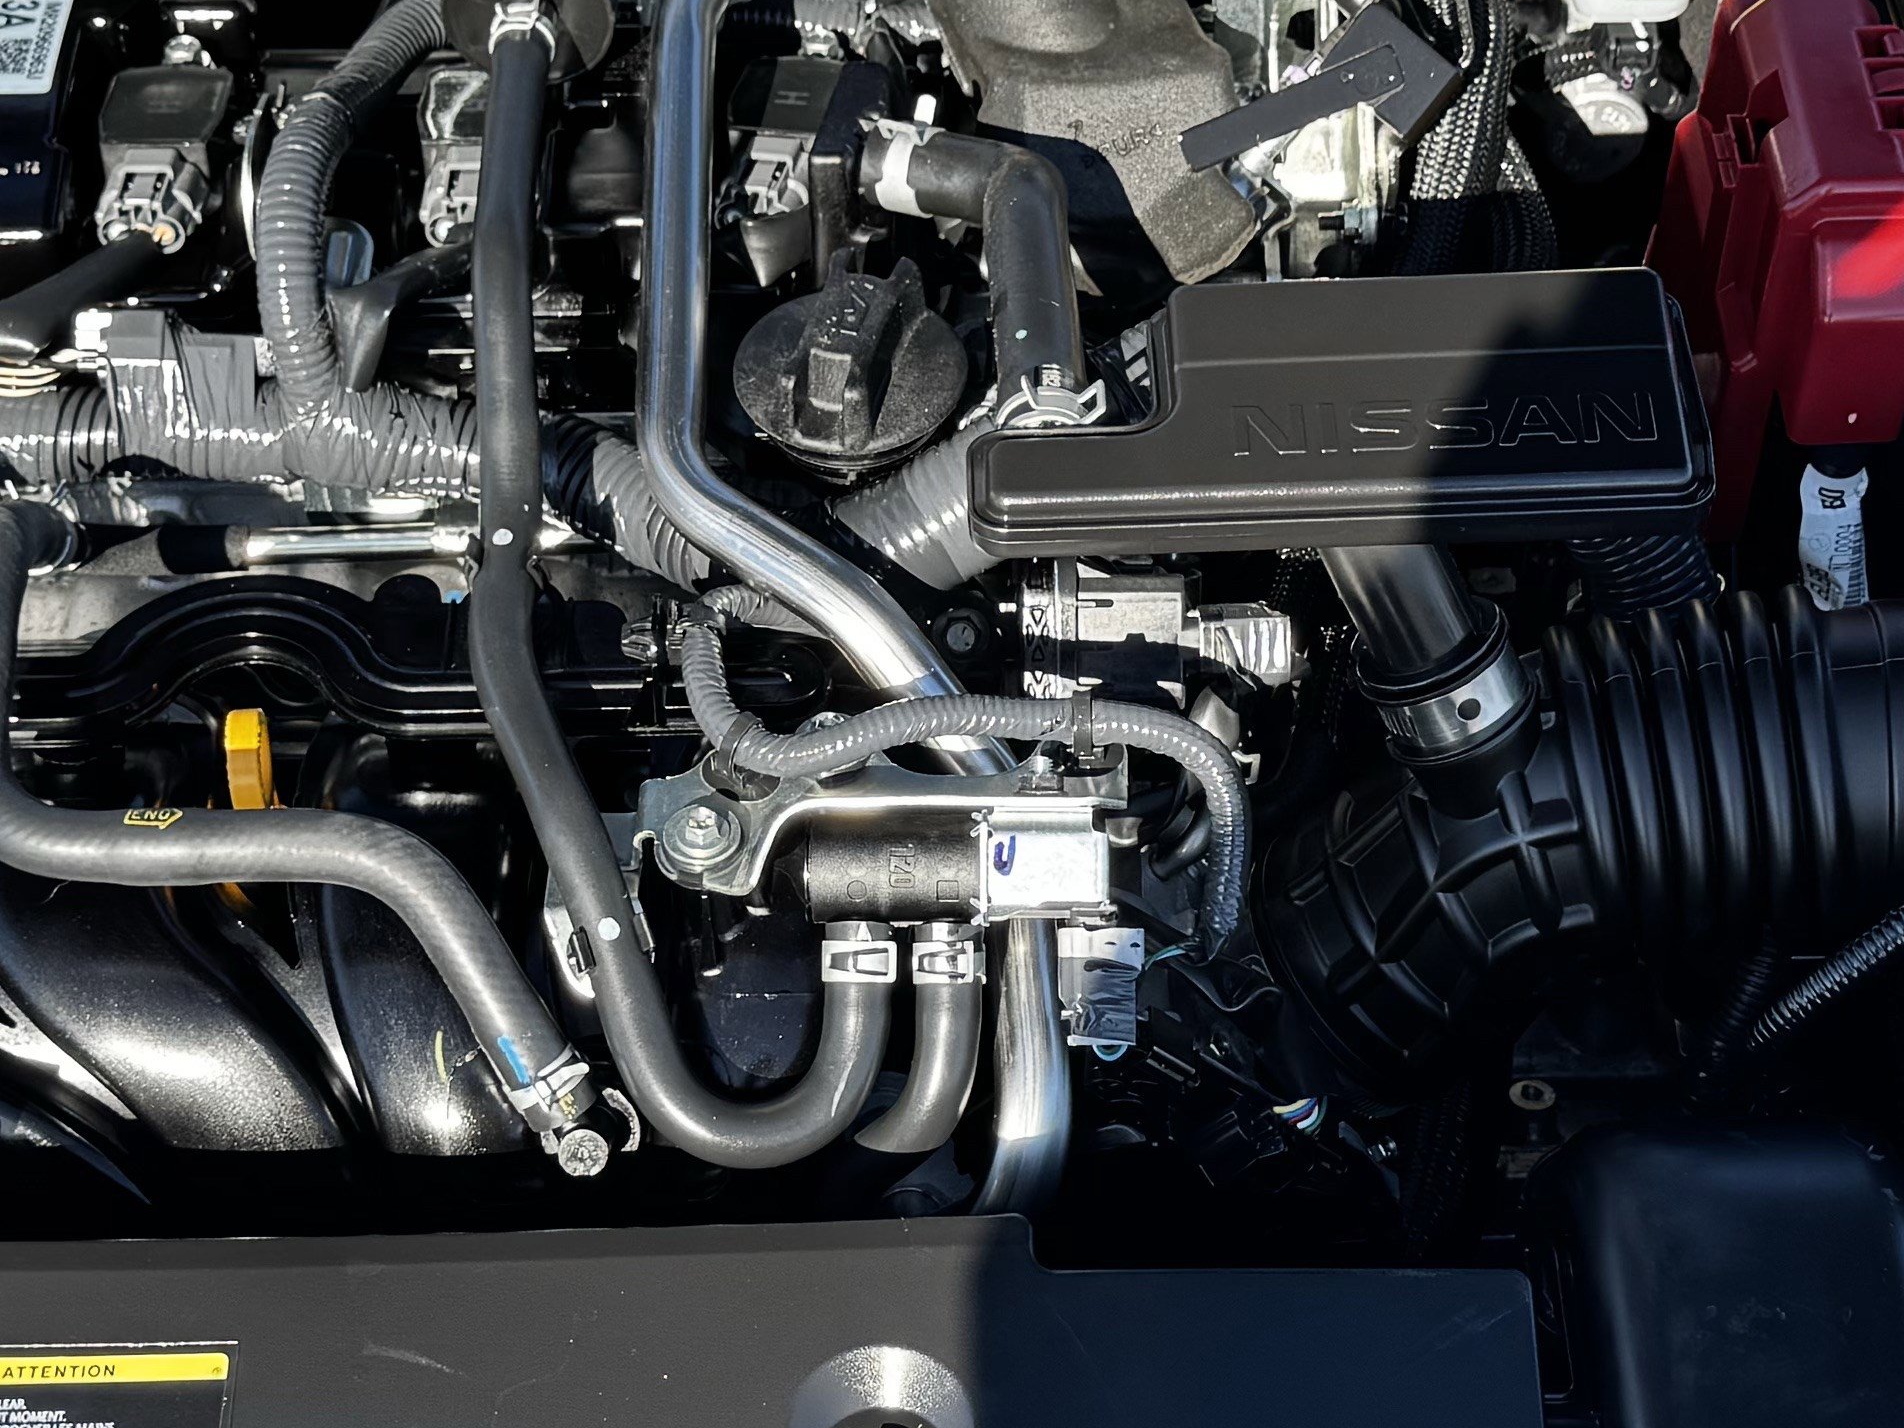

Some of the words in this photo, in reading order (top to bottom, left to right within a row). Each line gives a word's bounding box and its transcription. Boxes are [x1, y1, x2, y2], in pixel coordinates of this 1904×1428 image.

[1232, 390, 1662, 458] NISSAN
[1, 1364, 117, 1380] ATTENTION
[10, 1411, 67, 1422] MOMENT.
